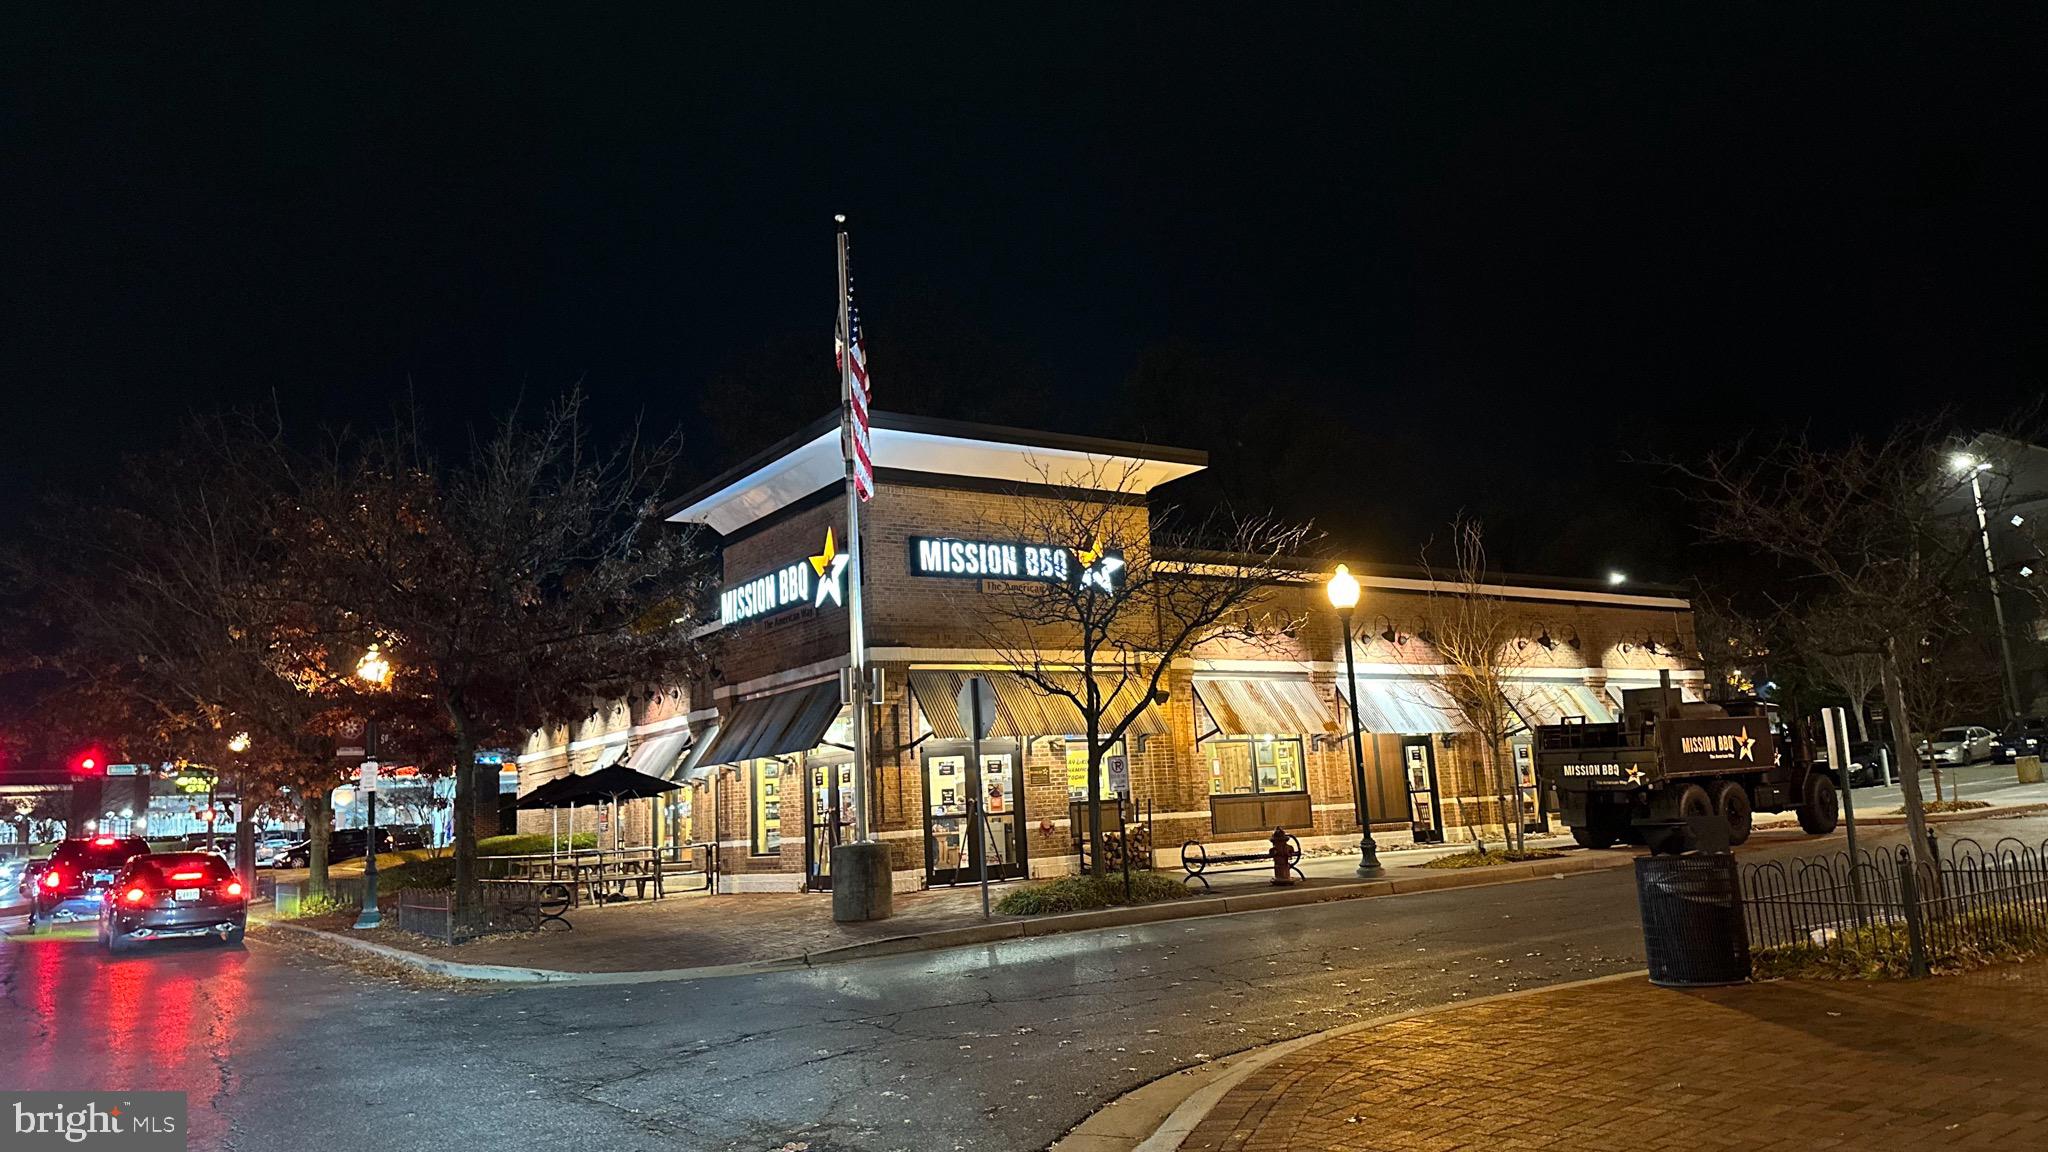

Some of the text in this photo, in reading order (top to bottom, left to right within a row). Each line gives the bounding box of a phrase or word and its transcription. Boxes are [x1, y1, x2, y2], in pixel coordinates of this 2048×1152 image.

[919, 540, 1068, 581] MISSION BBQ
[720, 561, 809, 626] MISSION BBQ
[986, 581, 1001, 592] The
[1681, 734, 1735, 754] MISSION BBQ
[1563, 763, 1620, 777] MISSION BBQ
